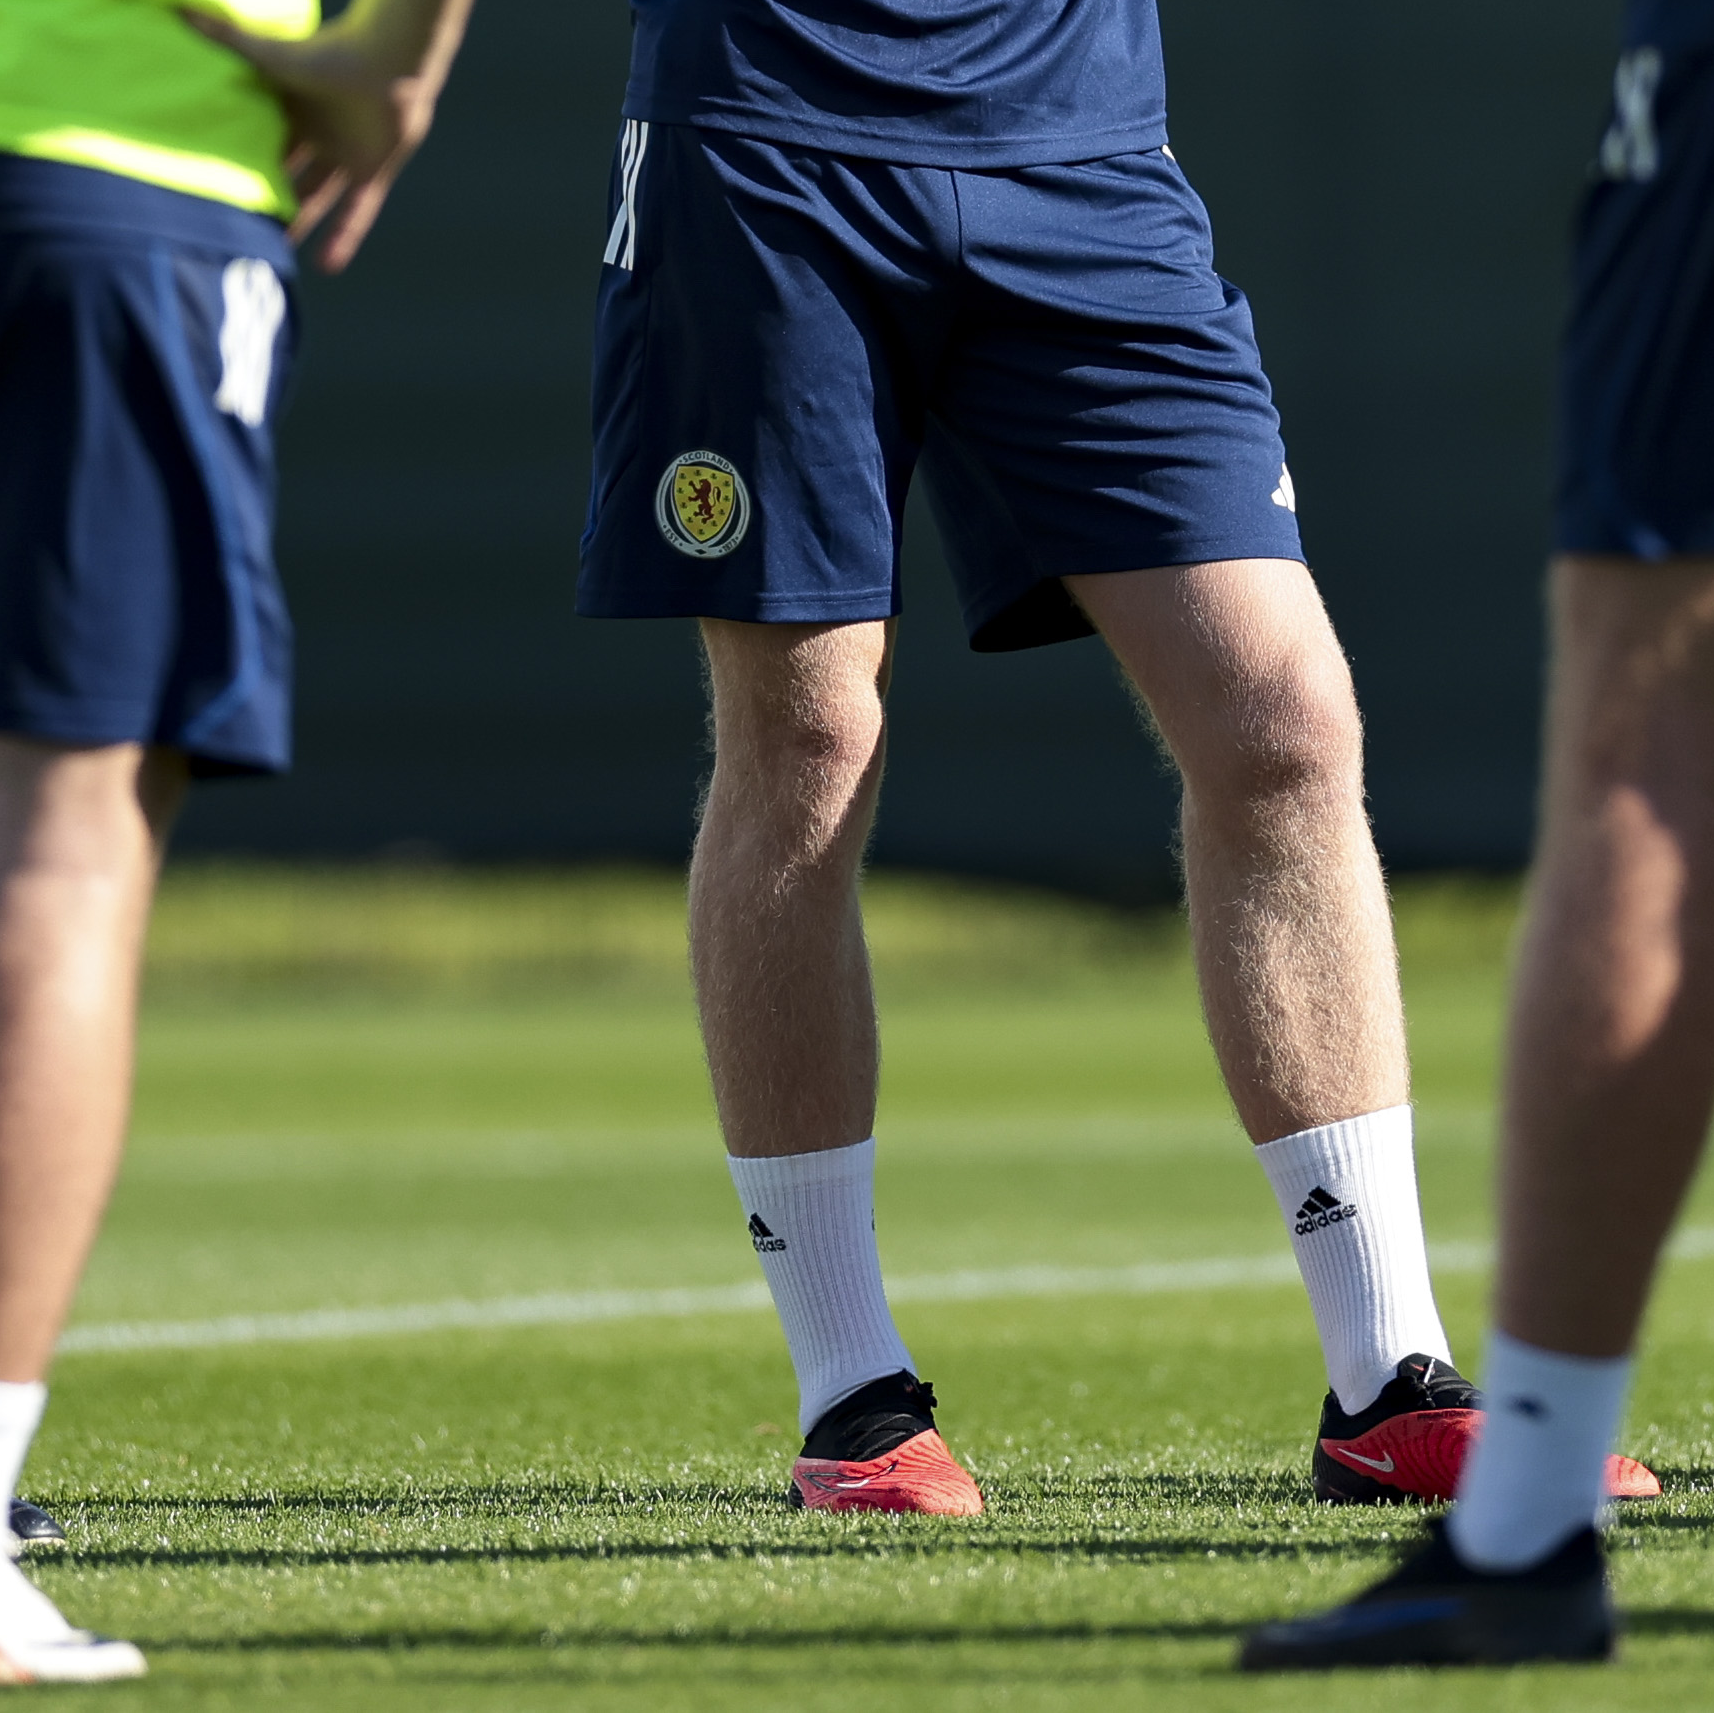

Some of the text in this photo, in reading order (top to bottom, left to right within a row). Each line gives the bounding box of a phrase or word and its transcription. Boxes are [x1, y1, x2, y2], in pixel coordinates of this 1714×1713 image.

[682, 451, 730, 470] SCOTLAND
[665, 527, 679, 544] EST
[1294, 1204, 1358, 1236] adidas
